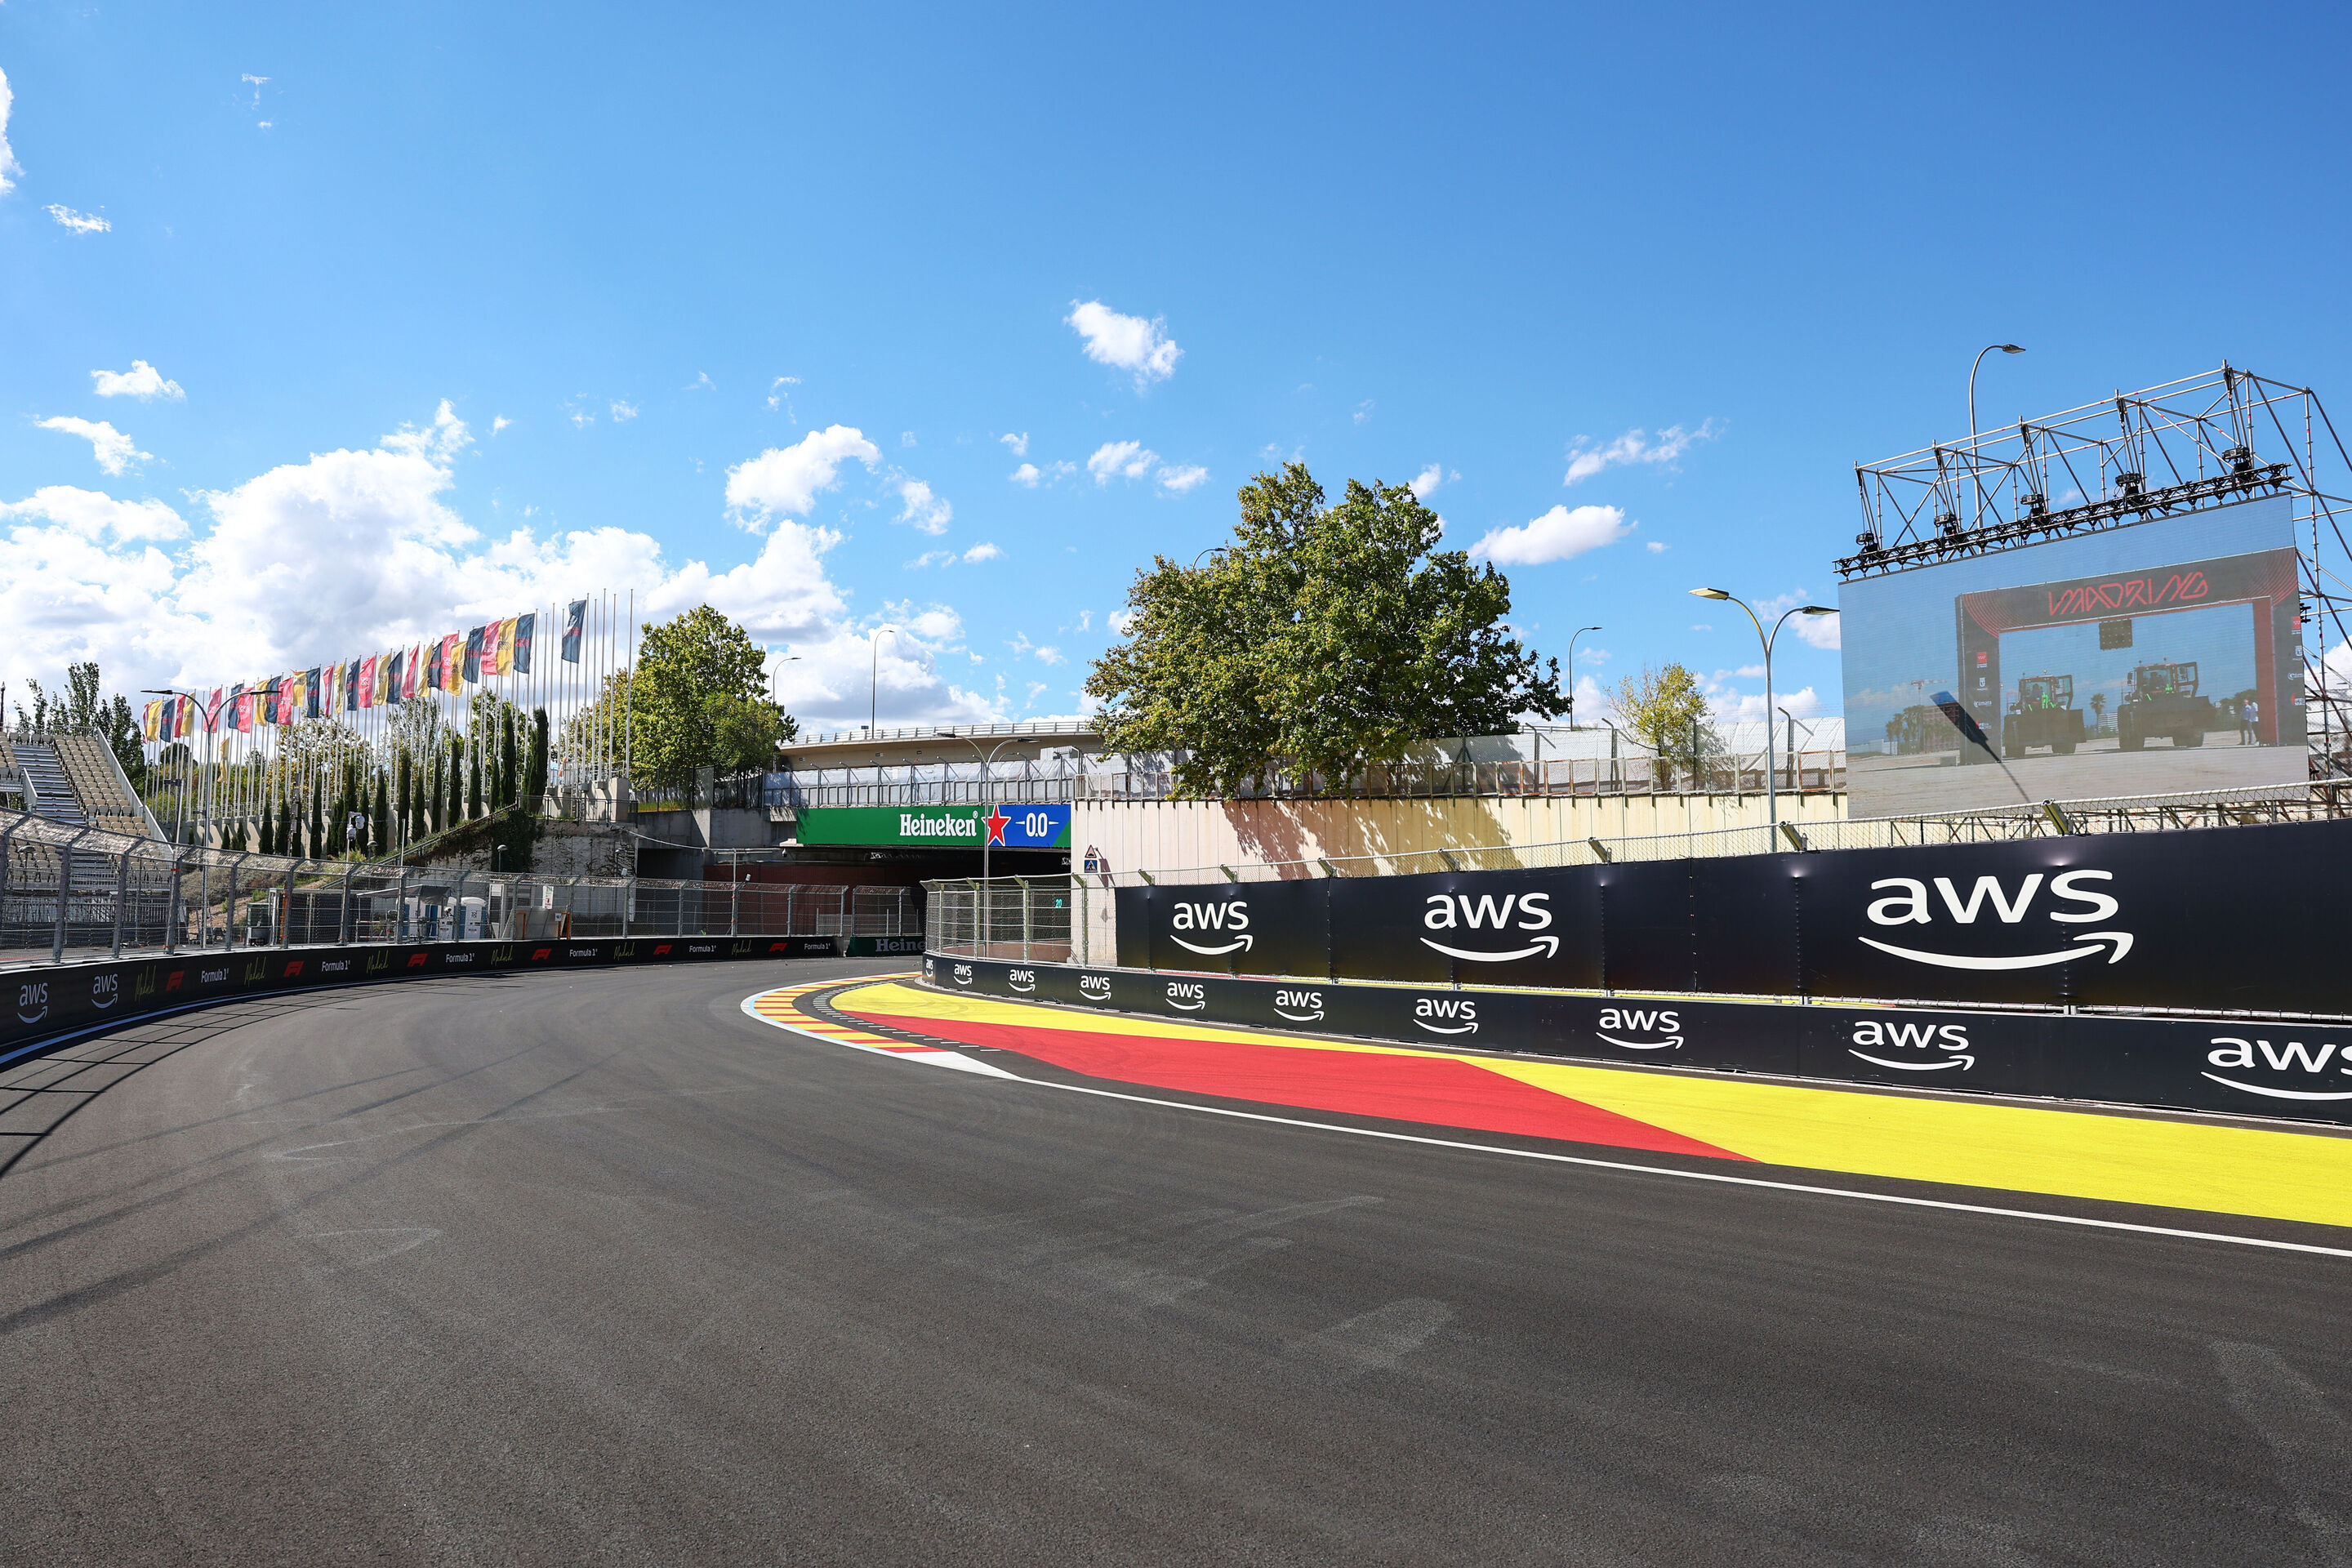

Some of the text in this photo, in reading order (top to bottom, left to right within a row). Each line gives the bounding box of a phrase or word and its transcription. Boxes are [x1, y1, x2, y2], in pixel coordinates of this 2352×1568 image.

[1867, 869, 2119, 926] aws
[1173, 901, 1250, 930] aws
[1424, 892, 1552, 930] aws
[445, 954, 468, 963] Formula
[569, 949, 592, 957] Formula
[322, 960, 345, 972] Formula
[925, 958, 933, 970] aws
[954, 963, 972, 977] aws
[93, 973, 118, 994] aws
[201, 969, 223, 983] Formula
[1009, 969, 1035, 983] aws
[1080, 975, 1111, 991] aws
[20, 982, 48, 1006] aws
[1166, 982, 1205, 1000] aws
[1275, 990, 1323, 1009] aws
[1415, 998, 1477, 1020] aws
[1599, 1008, 1681, 1033] aws
[1852, 1020, 1969, 1051] aws
